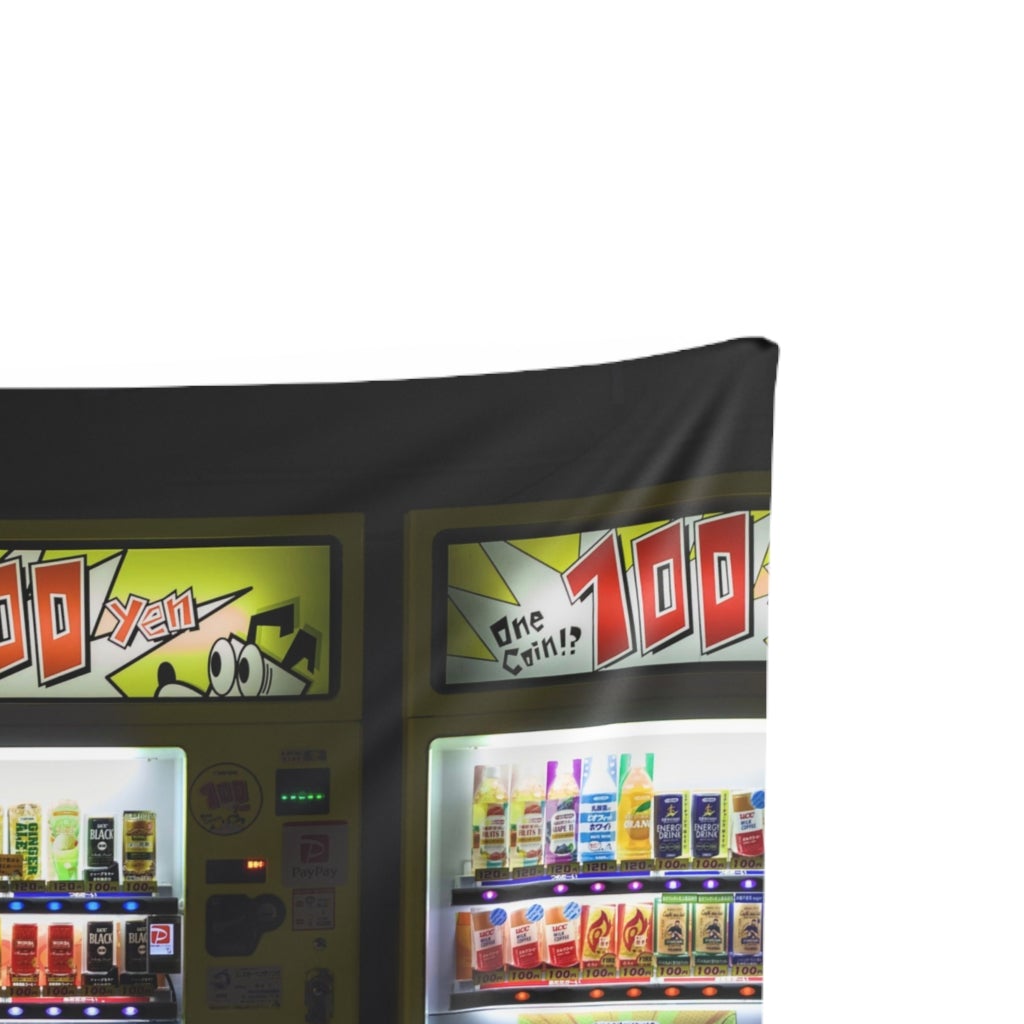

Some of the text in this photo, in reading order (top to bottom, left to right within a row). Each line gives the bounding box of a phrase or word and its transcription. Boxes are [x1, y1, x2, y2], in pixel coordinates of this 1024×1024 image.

[561, 510, 754, 671] 100
[104, 586, 199, 648] yen
[490, 610, 544, 648] One
[502, 626, 582, 676] Coin!?
[27, 822, 39, 876] GINGER
[89, 829, 114, 840] BLACK
[292, 865, 338, 880] PayPay
[89, 933, 113, 944] BLACK
